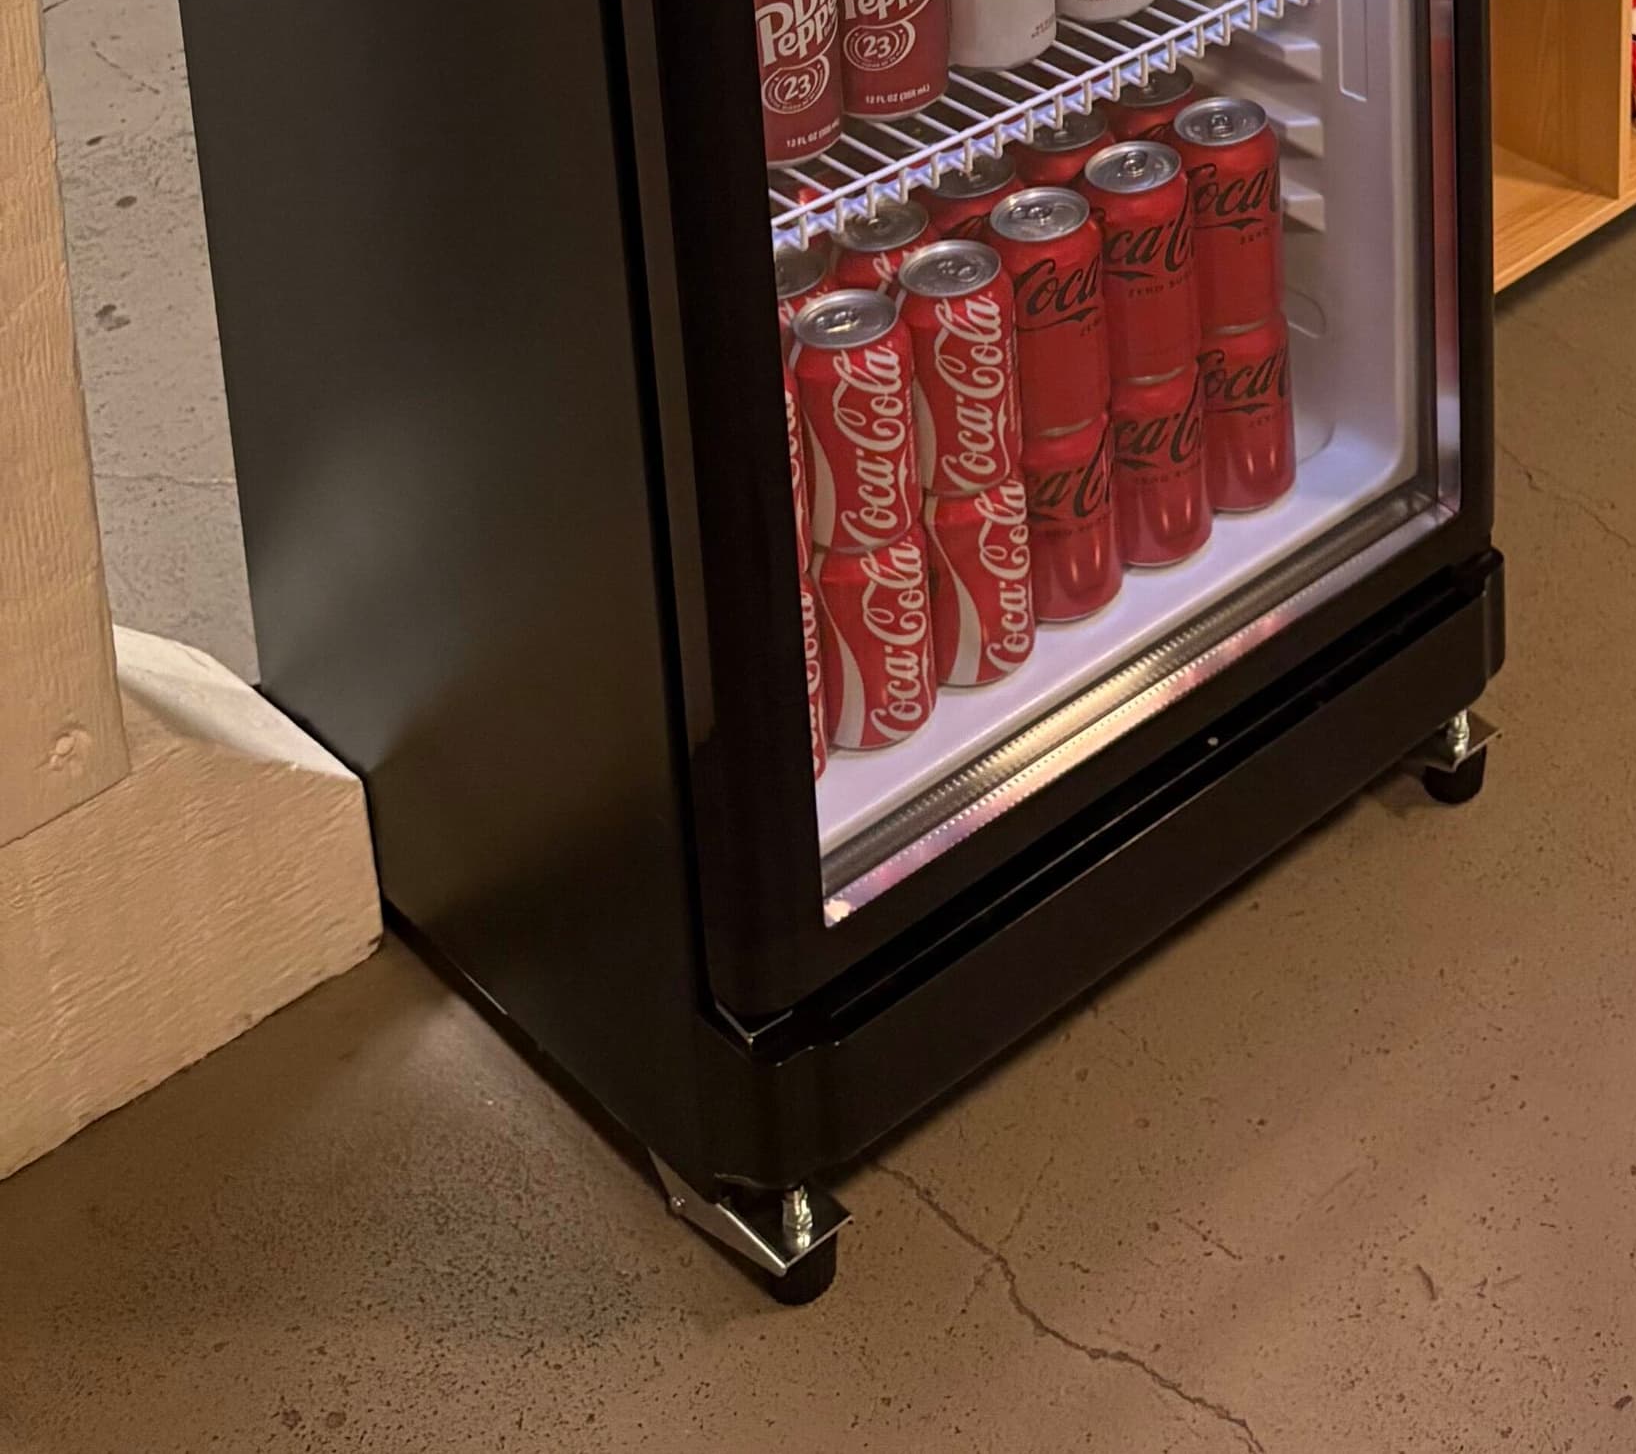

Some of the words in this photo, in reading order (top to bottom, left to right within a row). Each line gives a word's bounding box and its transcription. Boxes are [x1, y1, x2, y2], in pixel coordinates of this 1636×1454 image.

[863, 35, 892, 59] 23
[783, 75, 812, 101] 23
[866, 94, 875, 104] 12
[876, 93, 886, 104] FL
[888, 91, 898, 103] OZ
[787, 137, 797, 148] 12
[934, 291, 1005, 492] Coca-Cola
[832, 340, 906, 547] Coca-Cola
[861, 535, 928, 742] Coca-Cola
